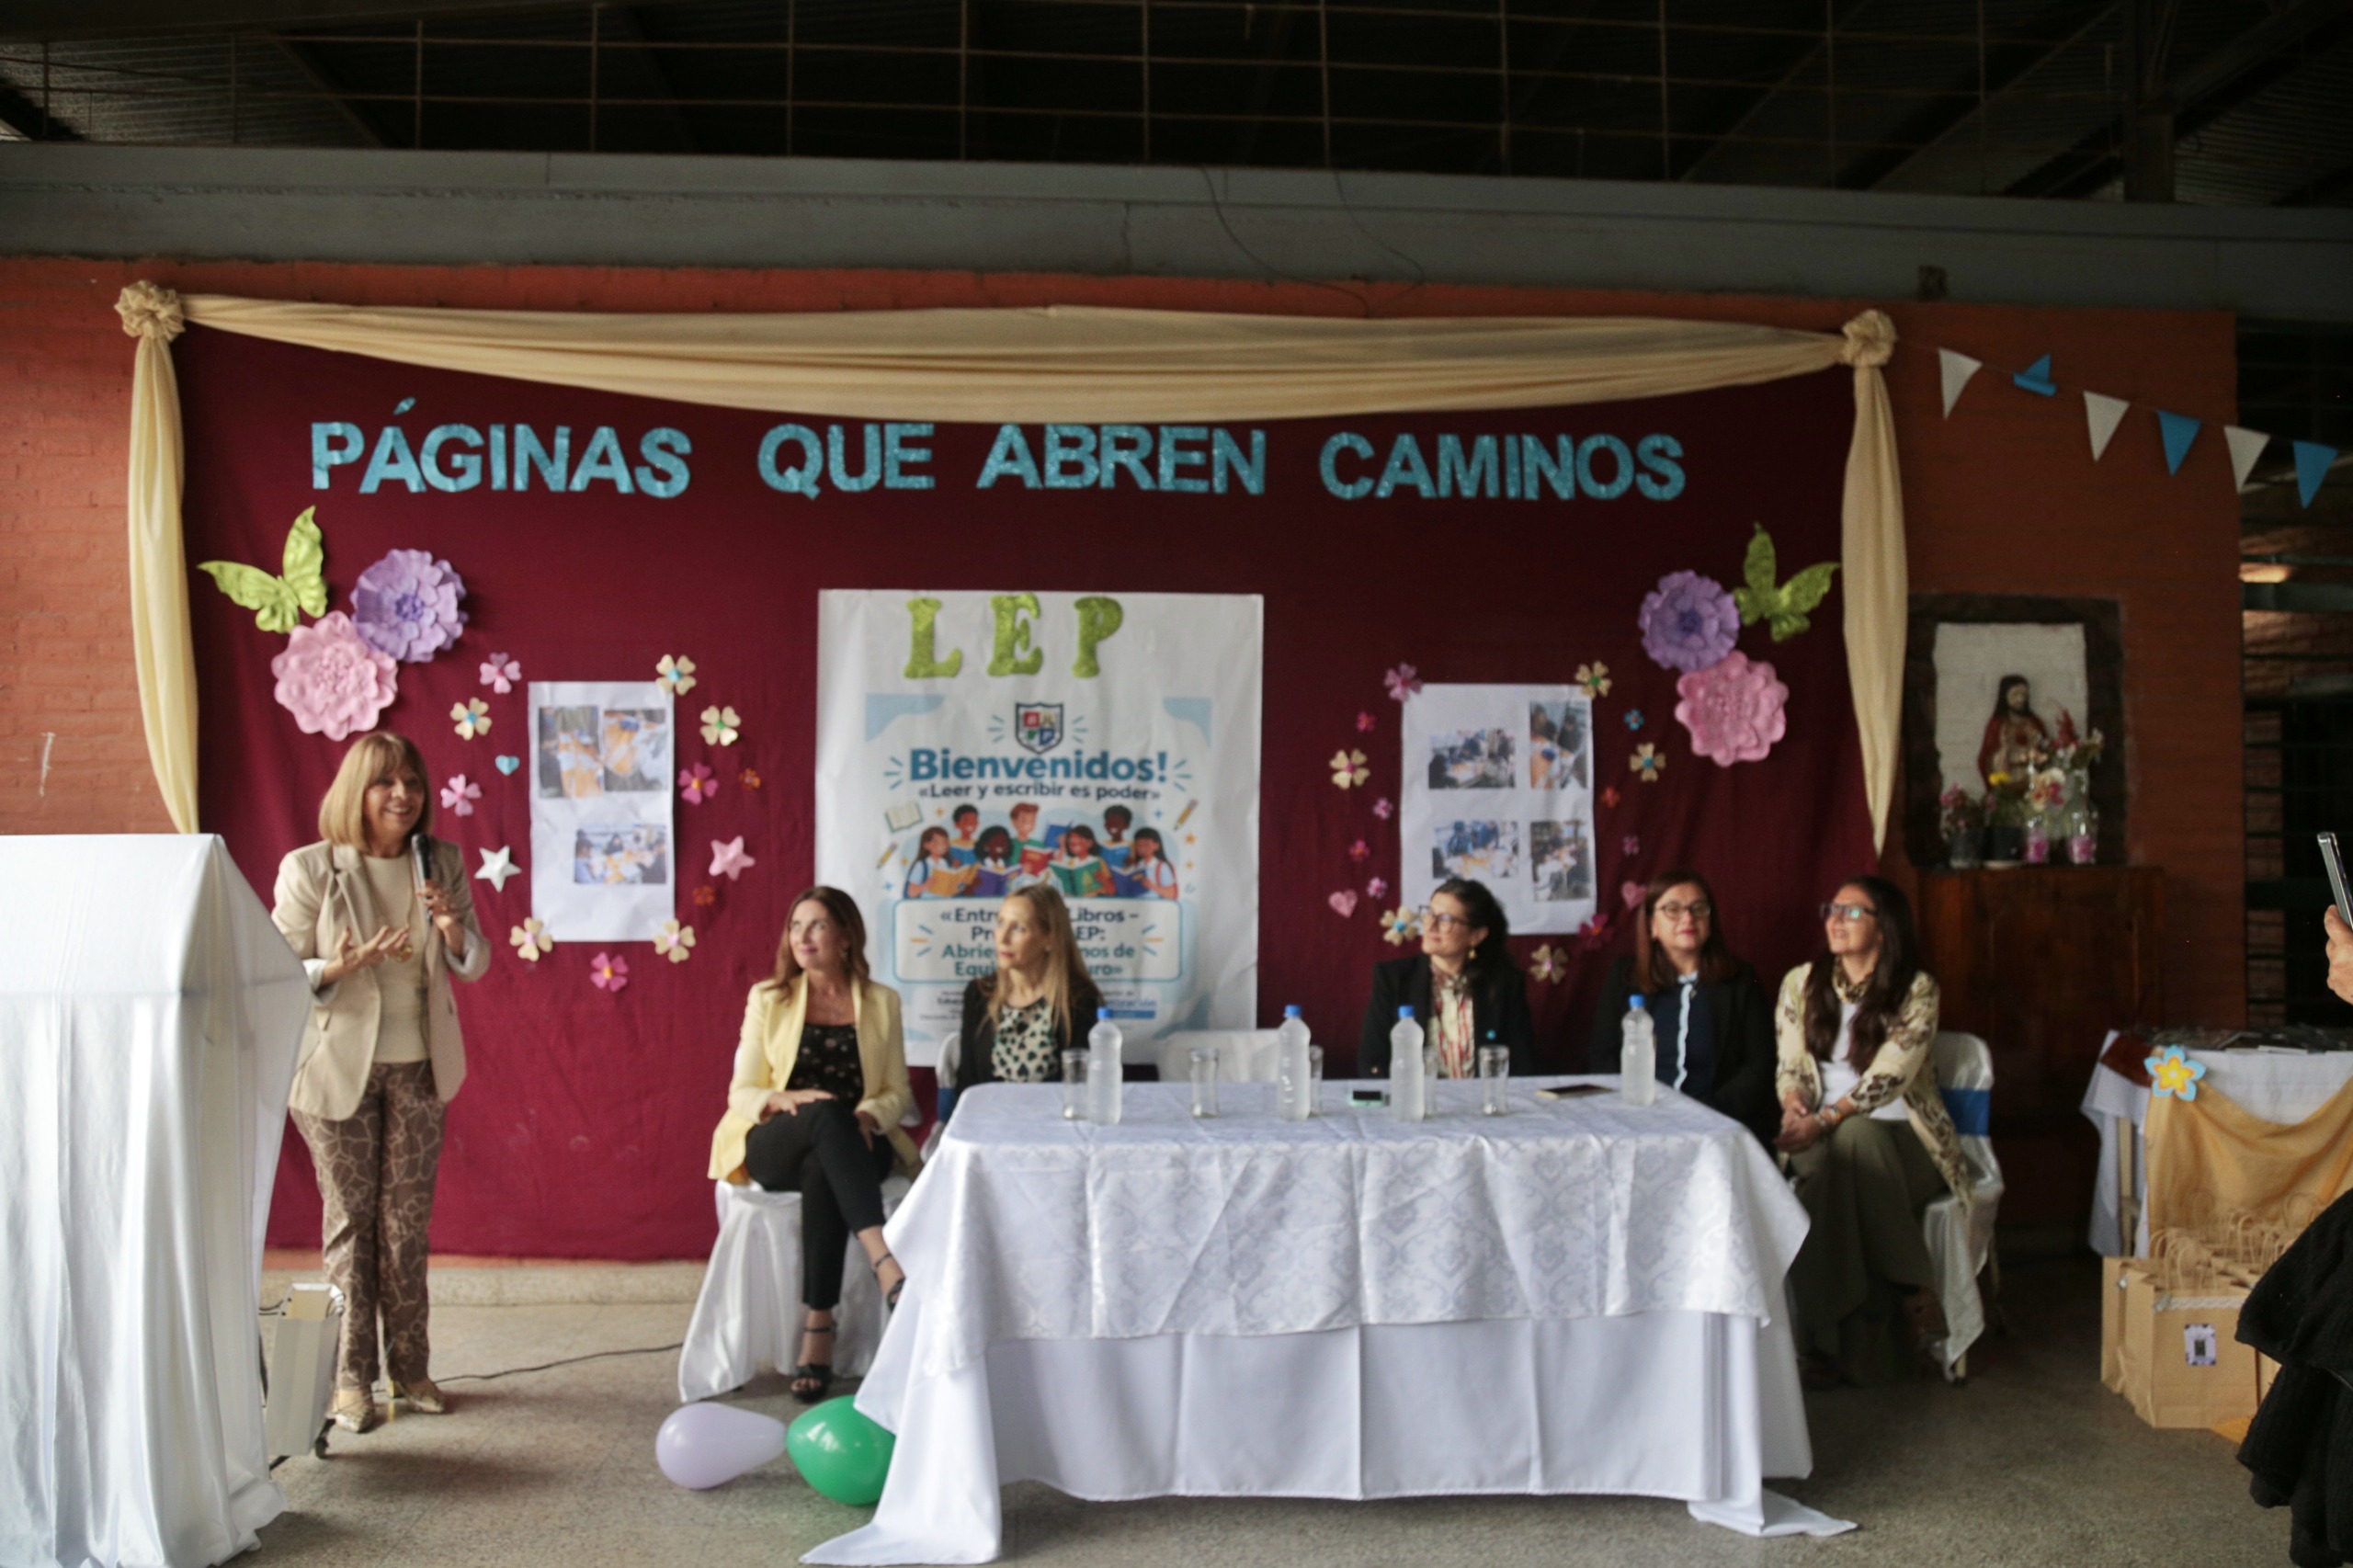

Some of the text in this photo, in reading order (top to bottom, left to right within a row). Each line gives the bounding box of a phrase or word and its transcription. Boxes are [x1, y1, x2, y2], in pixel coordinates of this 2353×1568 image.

[311, 397, 1686, 500] PÁGINAS QUE ABREN CAMINOS
[904, 592, 1123, 679] LEP
[910, 748, 1167, 782] Bienvenidos!
[977, 784, 988, 800] y
[994, 781, 1063, 798] escribir
[1071, 785, 1090, 798] es
[941, 907, 998, 923] «Entr
[1076, 926, 1105, 941] EP:
[941, 943, 995, 959] Abrie
[1113, 942, 1135, 959] de
